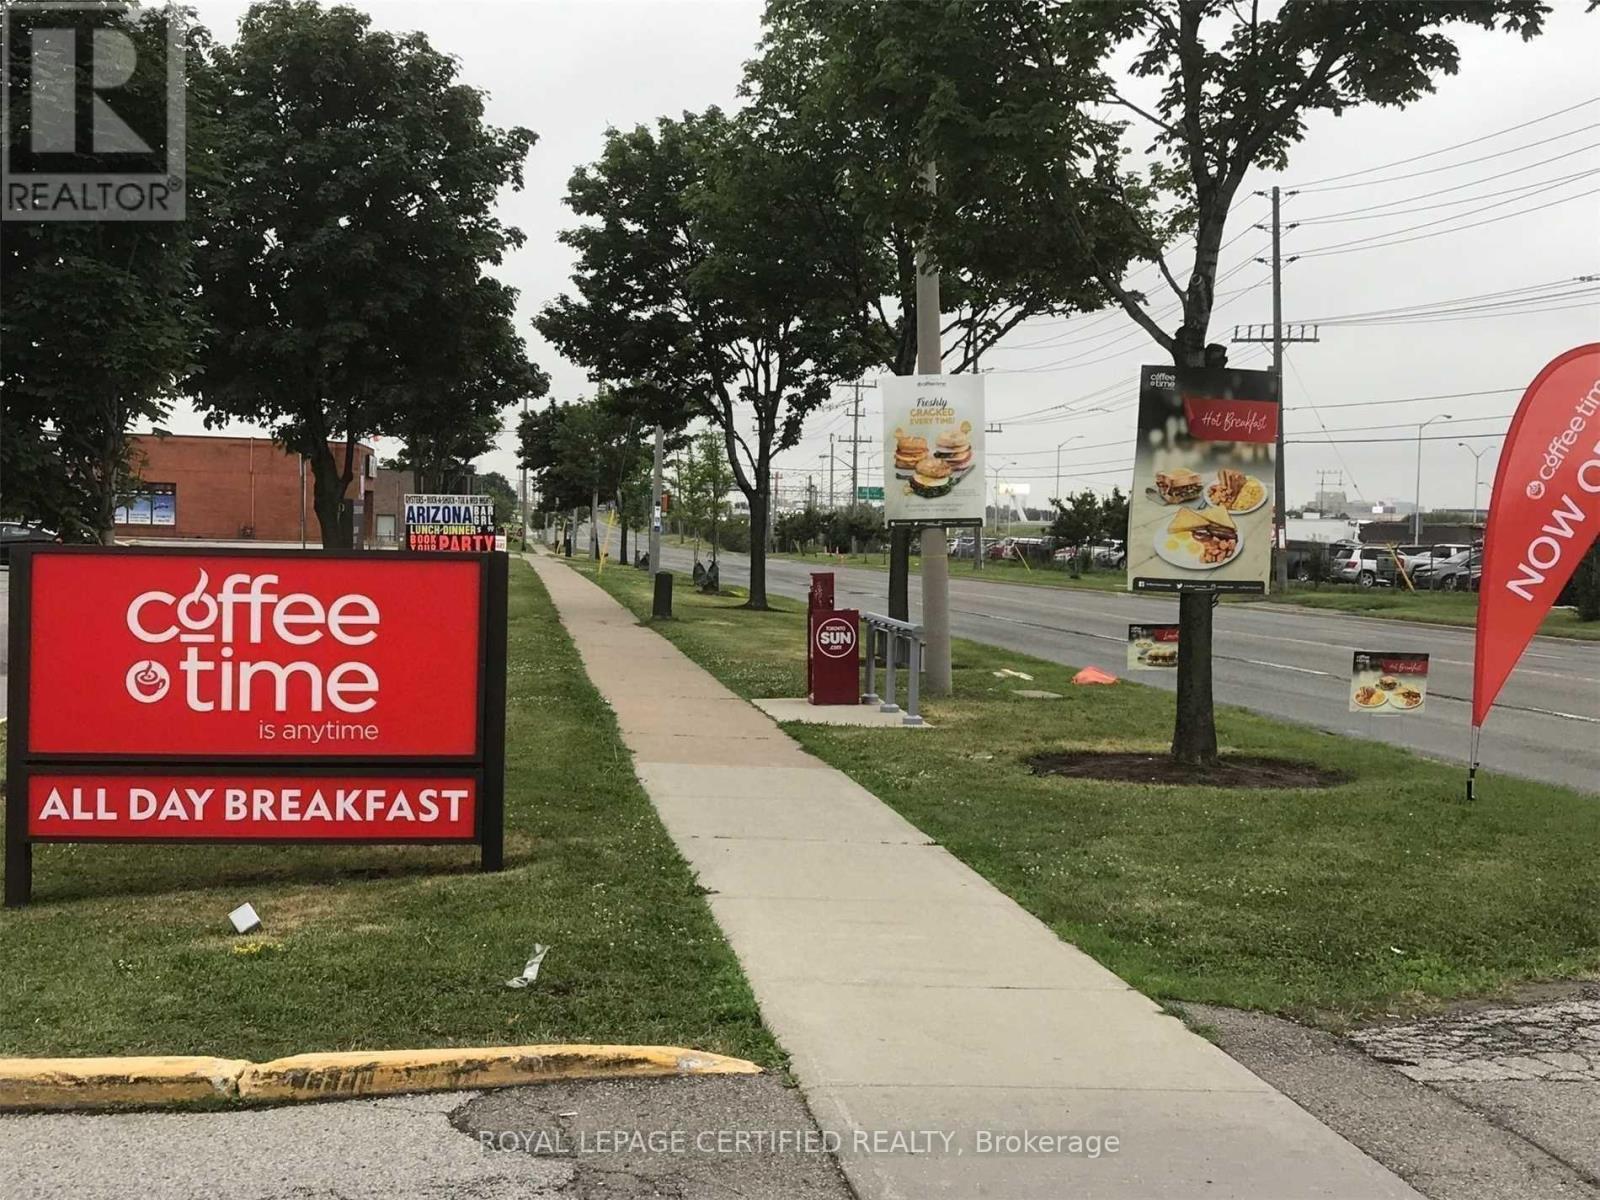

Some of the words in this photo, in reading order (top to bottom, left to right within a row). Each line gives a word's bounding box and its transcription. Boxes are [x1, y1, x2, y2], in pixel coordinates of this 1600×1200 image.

[910, 408, 955, 417] CRACKED
[916, 396, 948, 410] Freshly
[1201, 410, 1221, 427] Hot
[1223, 409, 1267, 434] Breakfast
[1539, 415, 1587, 481] coffee
[406, 505, 472, 524] ARIZONA
[473, 506, 494, 516] BAR
[410, 534, 436, 545] BOOK
[438, 535, 494, 551] PARTY
[1505, 493, 1587, 602] NOW
[126, 568, 381, 646] coffee
[820, 631, 851, 644] SUN
[179, 646, 380, 713] time
[258, 720, 276, 740] is
[282, 720, 380, 744] anytime
[38, 787, 118, 821] ALL
[128, 788, 215, 821] DAY
[224, 789, 470, 822] BREAKFAST
